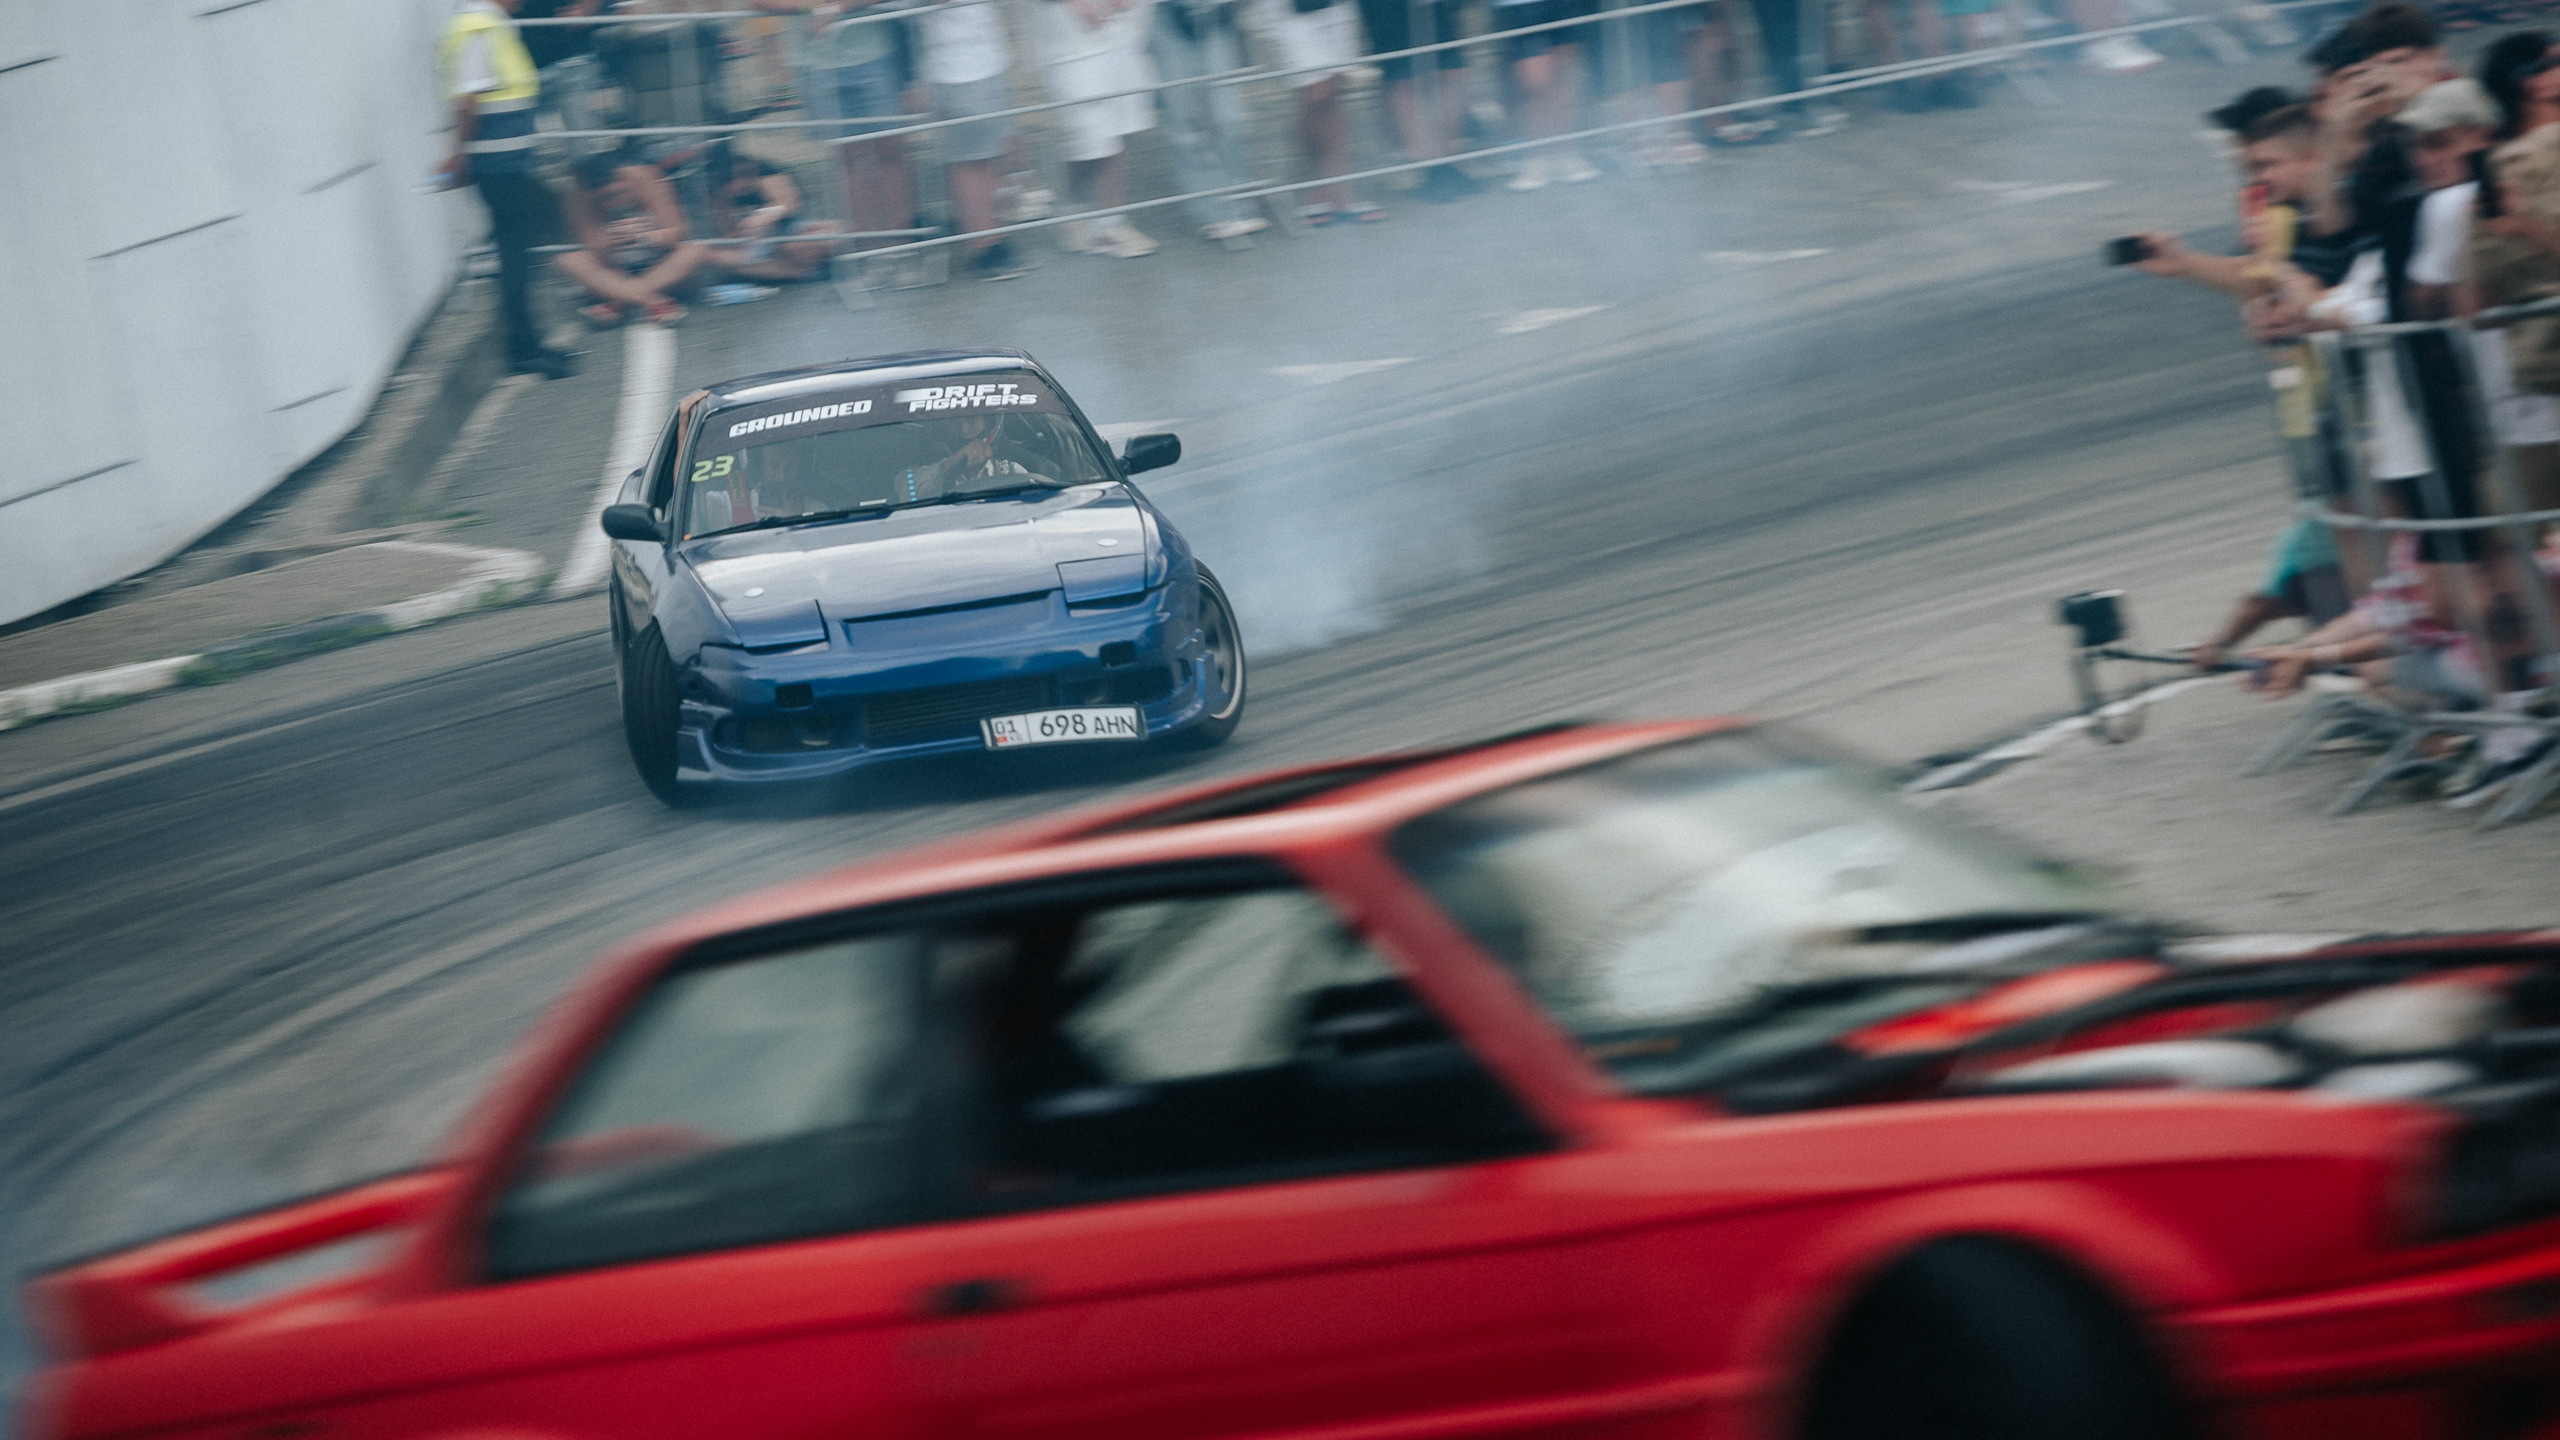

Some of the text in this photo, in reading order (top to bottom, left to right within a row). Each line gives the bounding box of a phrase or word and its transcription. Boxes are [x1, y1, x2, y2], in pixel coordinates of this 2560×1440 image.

[902, 383, 1018, 402] DRIFT
[908, 394, 1038, 413] FIGHTERS
[728, 399, 873, 439] GROUNDED
[691, 455, 735, 483] 23
[994, 713, 1136, 737] 01 698 AHN
